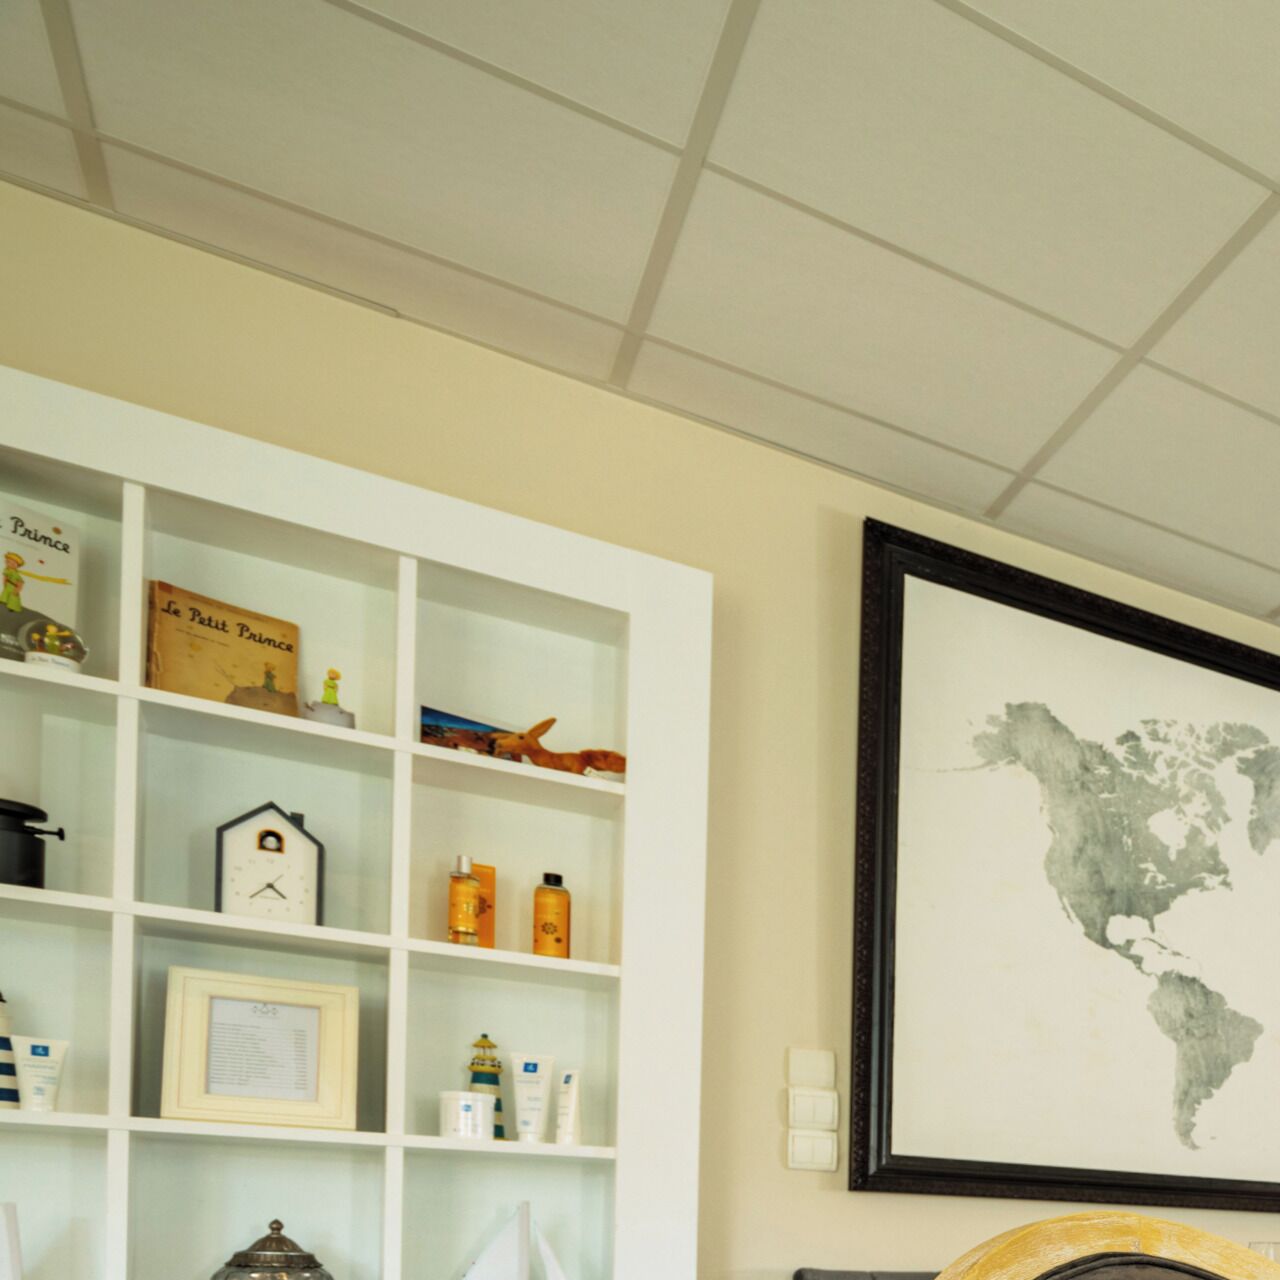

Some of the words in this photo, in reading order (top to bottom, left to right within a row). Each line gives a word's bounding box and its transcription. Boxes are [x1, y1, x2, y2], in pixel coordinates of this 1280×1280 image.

[10, 516, 70, 554] Prince
[161, 600, 181, 618] Le
[188, 607, 229, 633] Petit
[236, 622, 294, 653] Prince
